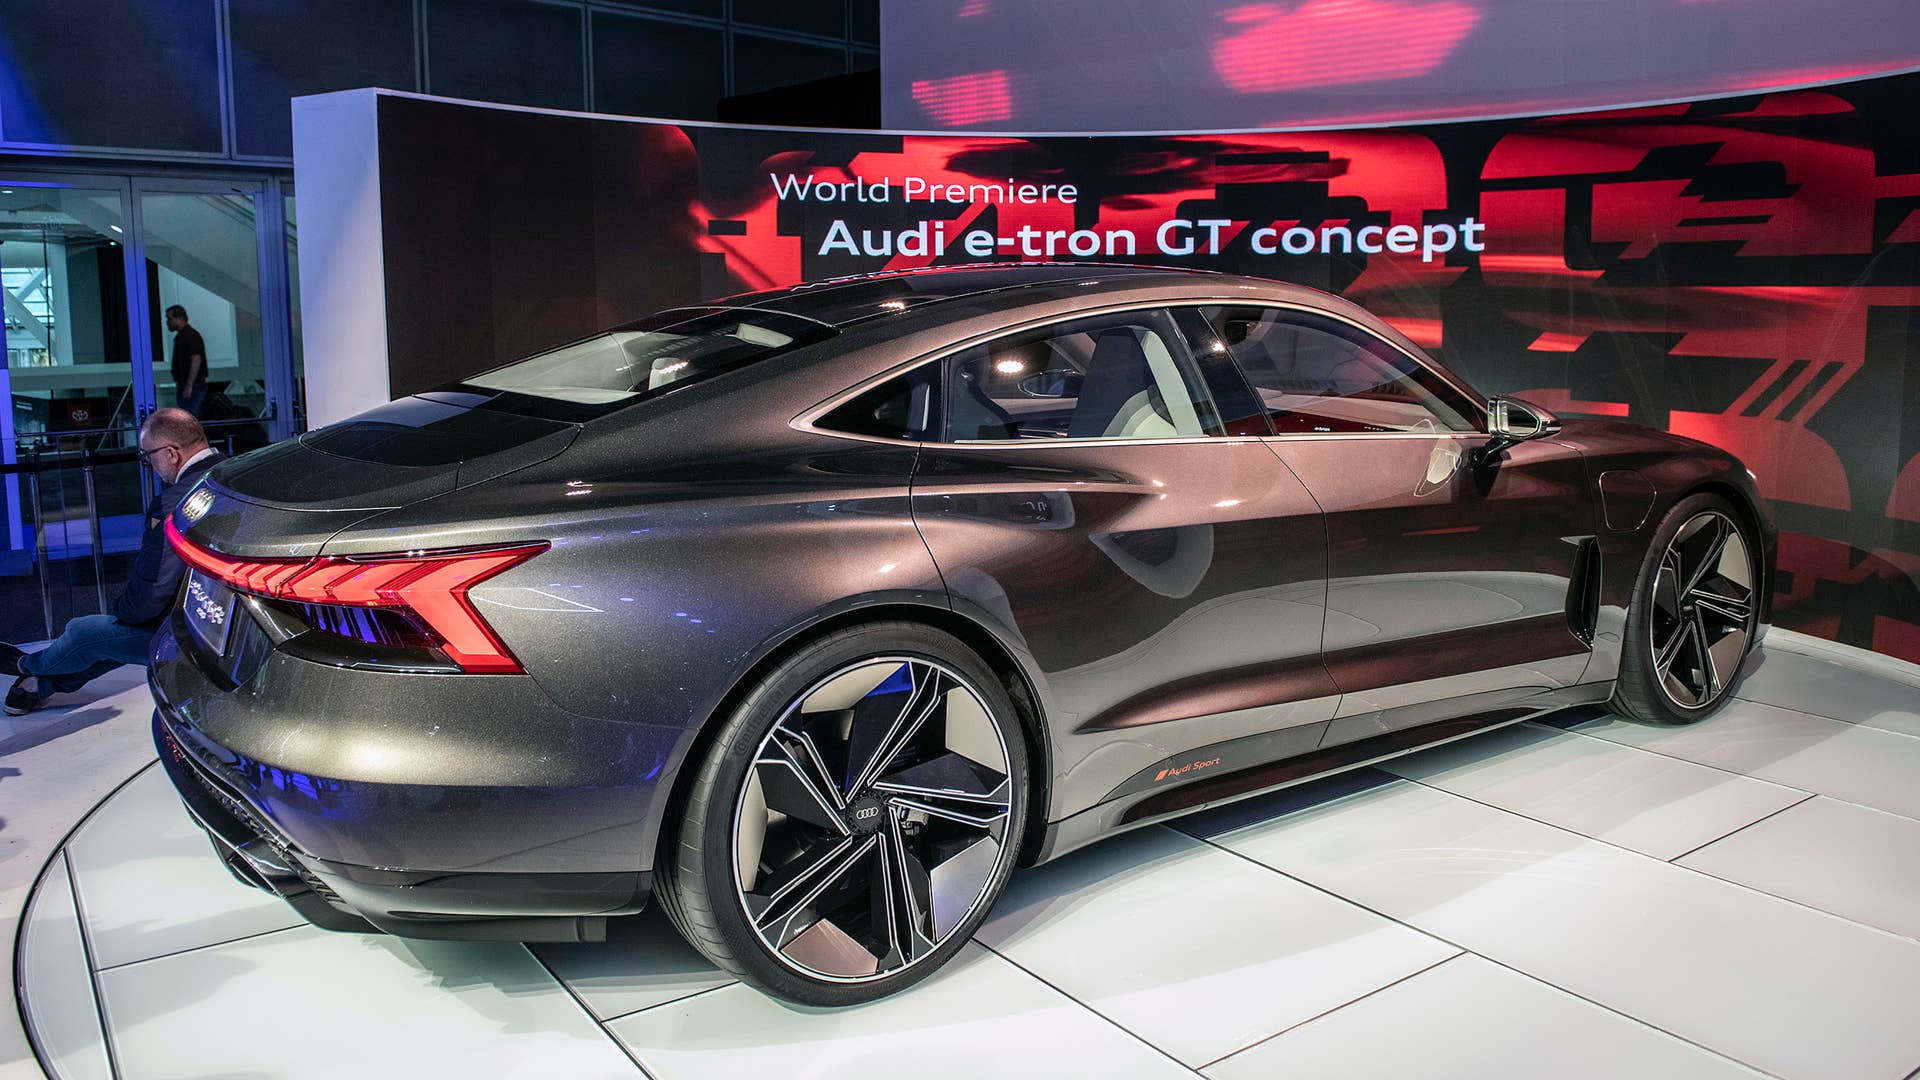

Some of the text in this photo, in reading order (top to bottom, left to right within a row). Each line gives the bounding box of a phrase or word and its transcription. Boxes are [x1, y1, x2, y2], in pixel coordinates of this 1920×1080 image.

[769, 172, 1079, 205] World Premiere
[817, 216, 1486, 263] Audi e-tron GT concept
[1167, 757, 1221, 777] Audi Sport
